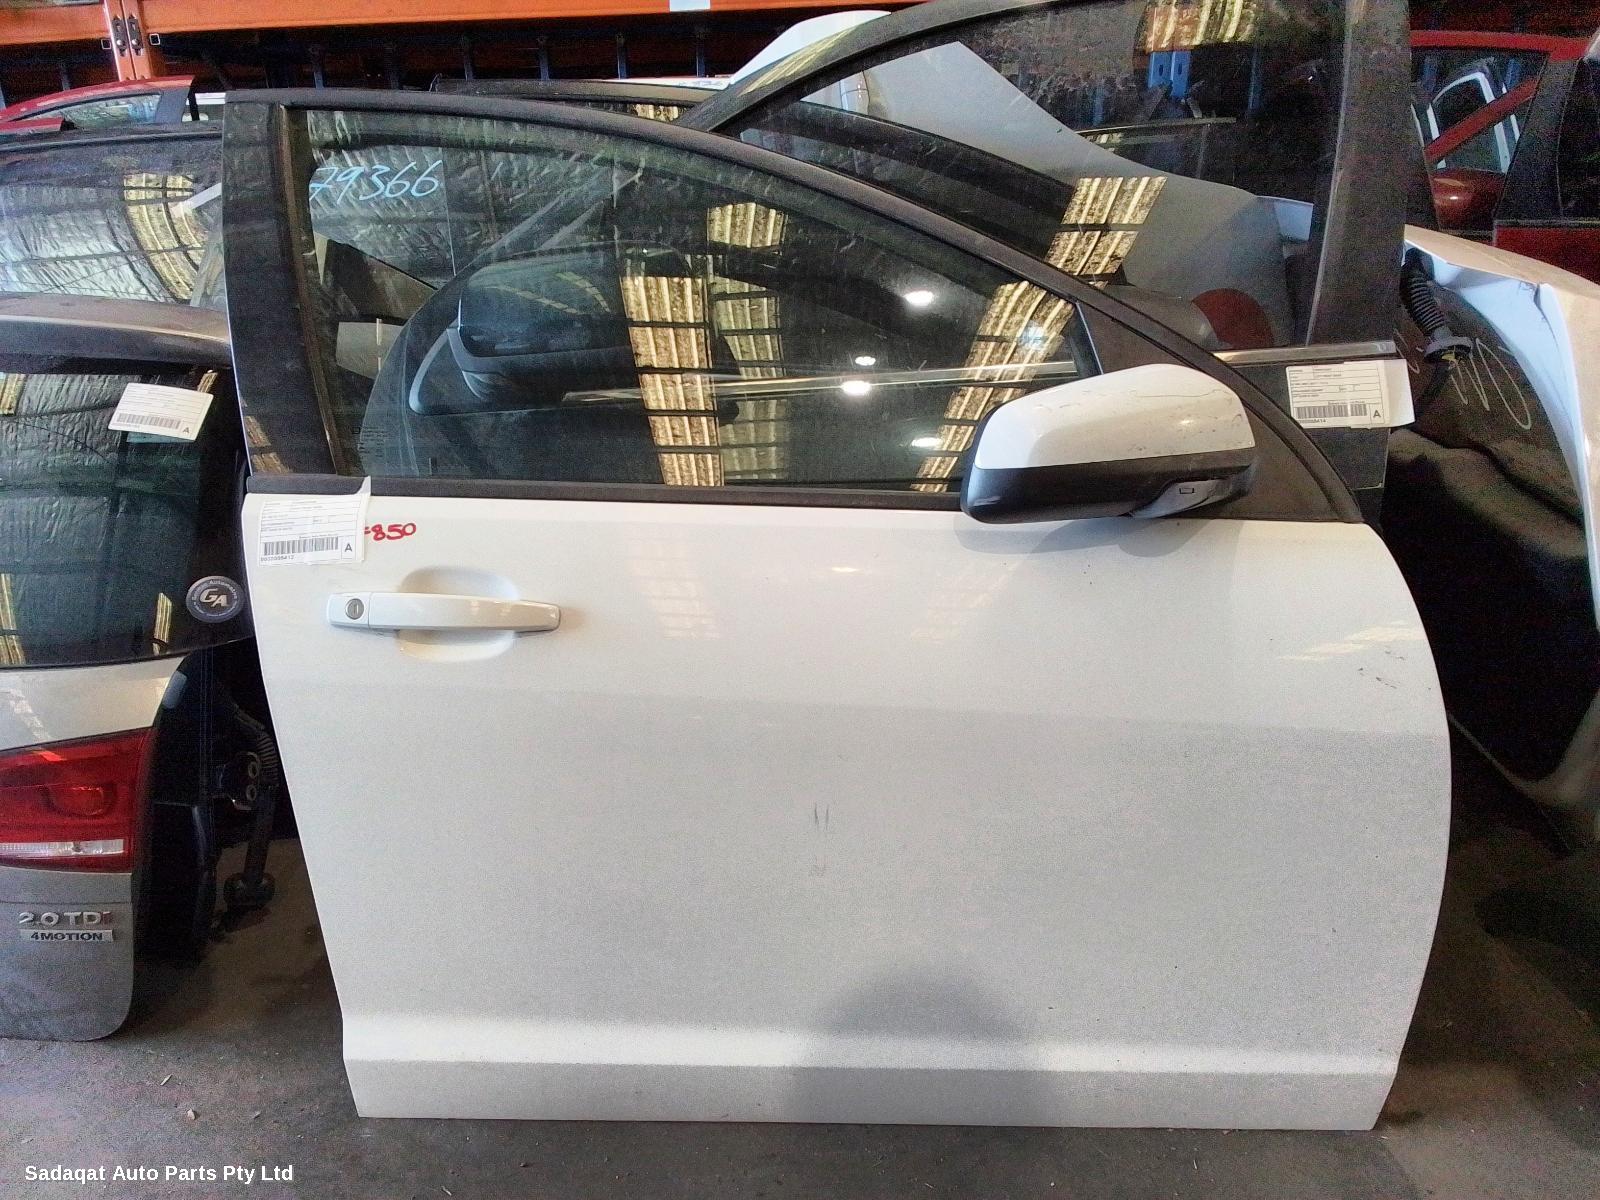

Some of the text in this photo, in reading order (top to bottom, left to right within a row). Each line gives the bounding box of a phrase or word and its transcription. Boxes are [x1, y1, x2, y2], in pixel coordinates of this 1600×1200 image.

[309, 159, 443, 205] 79366
[1373, 410, 1381, 418] A
[344, 543, 353, 552] A
[199, 588, 229, 608] GA
[31, 932, 103, 941] 4MOTION
